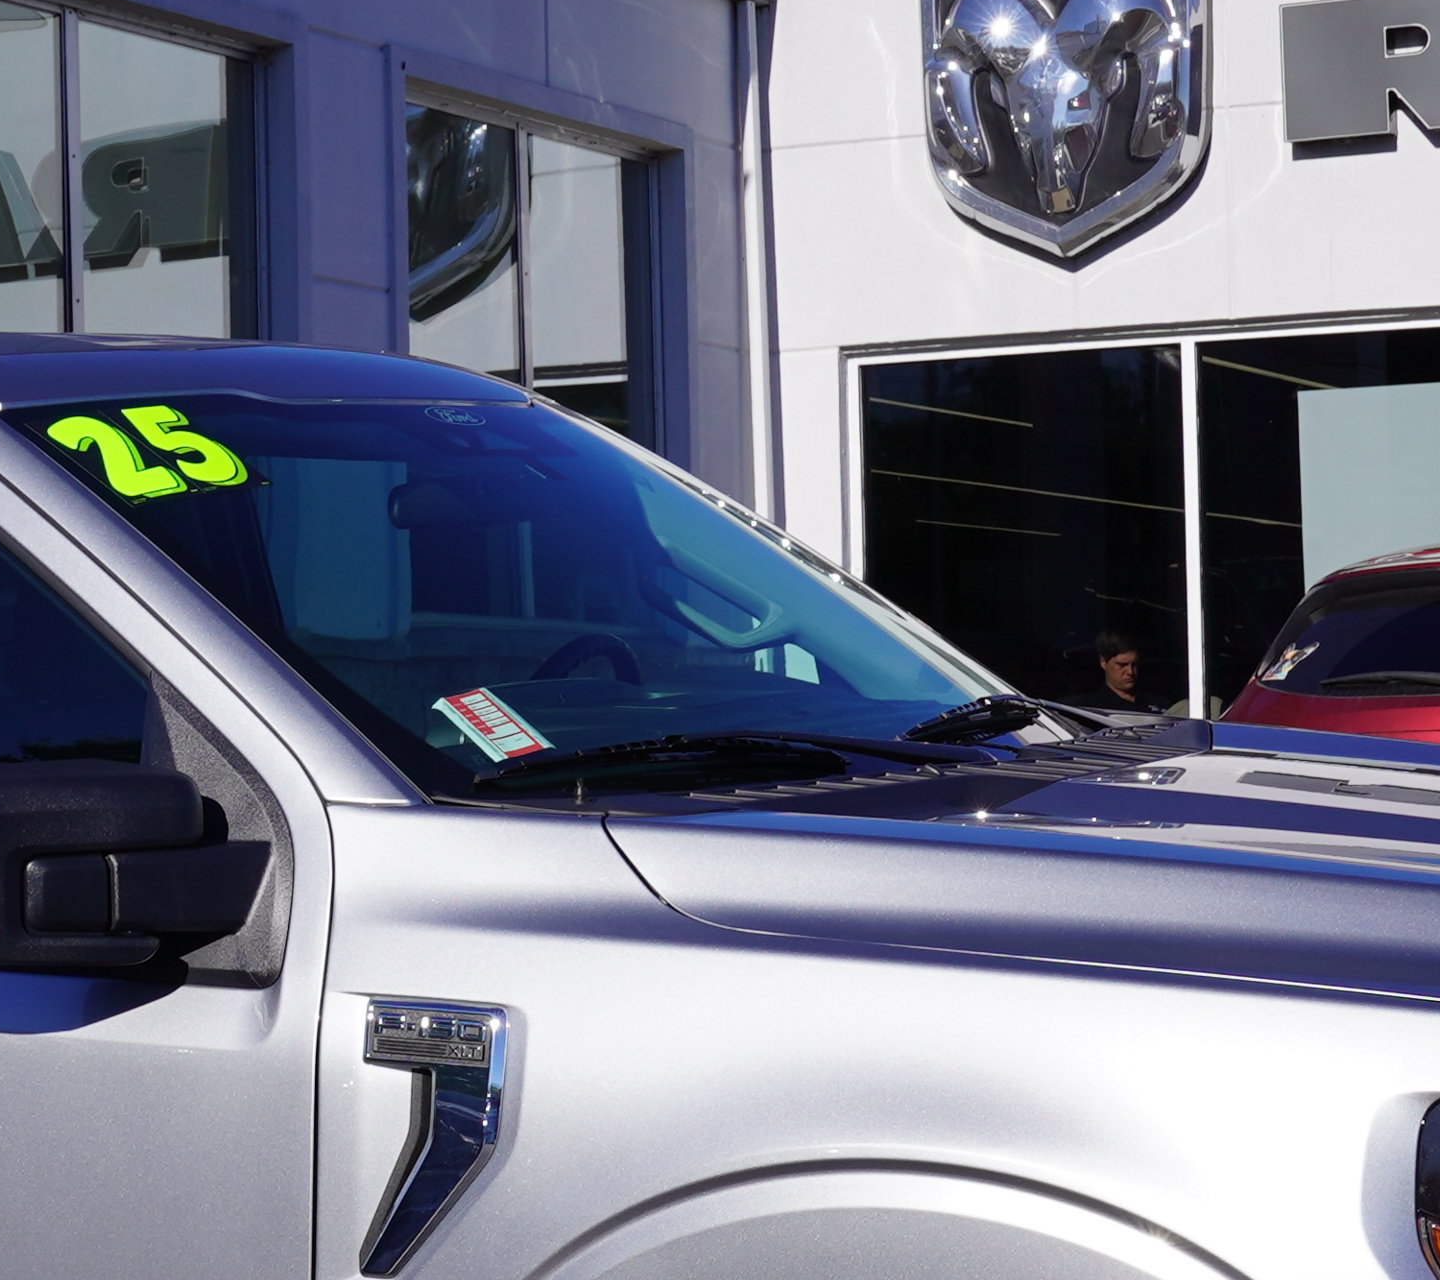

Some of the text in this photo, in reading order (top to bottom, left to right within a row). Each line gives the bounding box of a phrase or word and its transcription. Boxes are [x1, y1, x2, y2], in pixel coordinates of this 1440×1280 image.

[47, 405, 249, 498] 25
[375, 1012, 487, 1042] F-150
[447, 1043, 482, 1059] XLT
